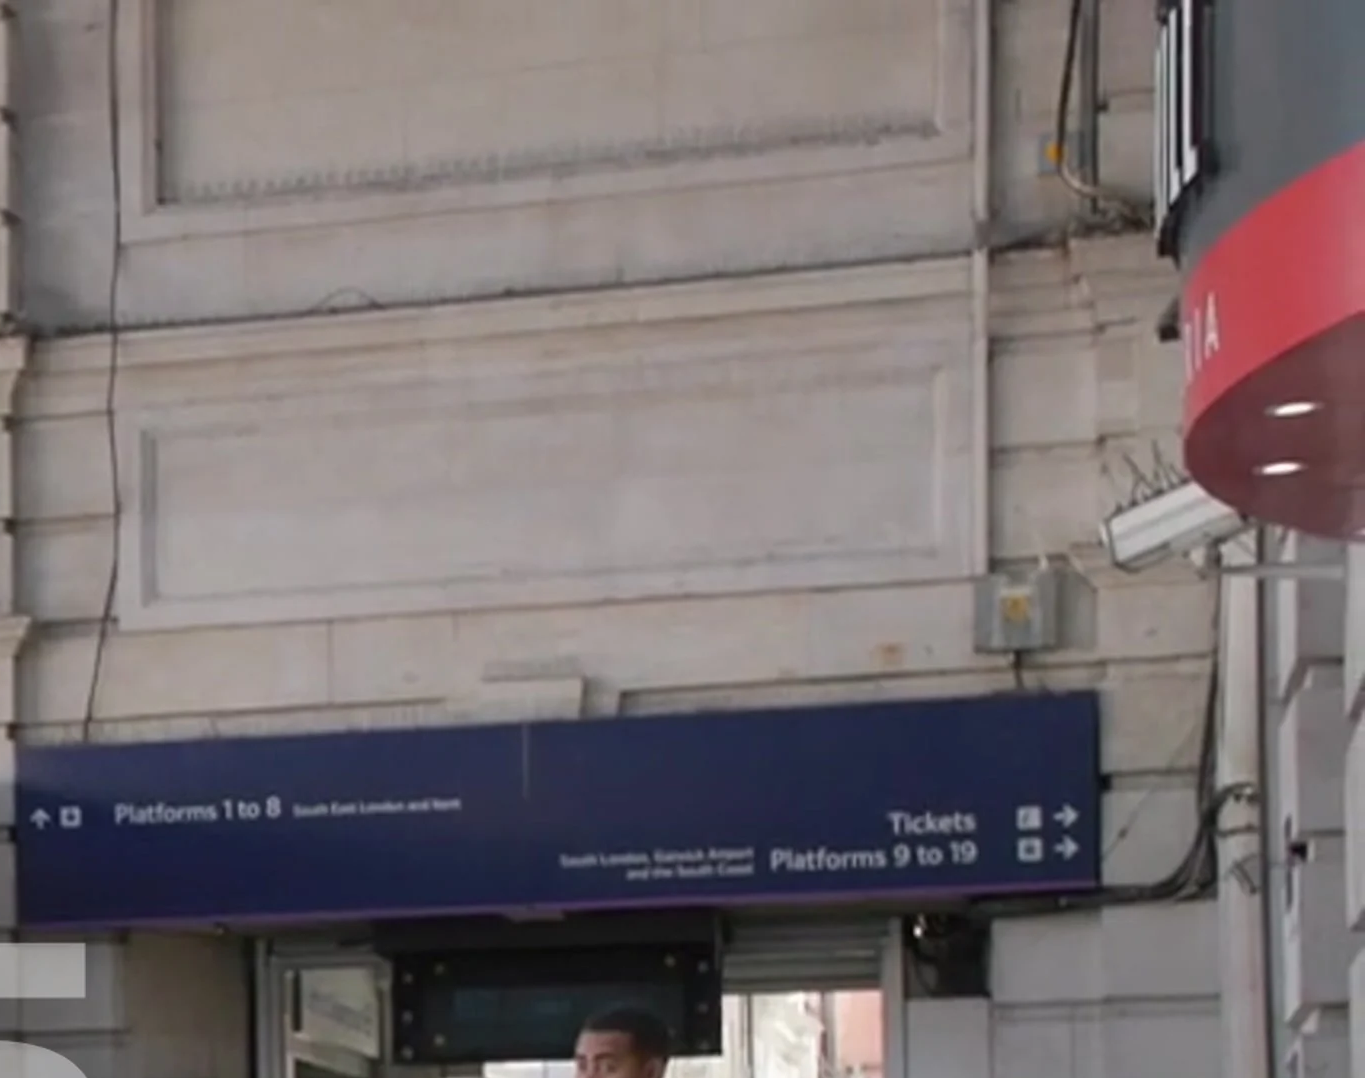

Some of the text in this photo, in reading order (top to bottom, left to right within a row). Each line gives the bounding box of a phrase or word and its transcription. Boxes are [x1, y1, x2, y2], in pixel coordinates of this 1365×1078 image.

[114, 801, 218, 824] Platforms
[222, 799, 234, 820] 1
[237, 800, 261, 819] to
[265, 795, 281, 818] 8
[888, 811, 977, 834] Tickets
[770, 840, 978, 872] Platforms 9 to 19
